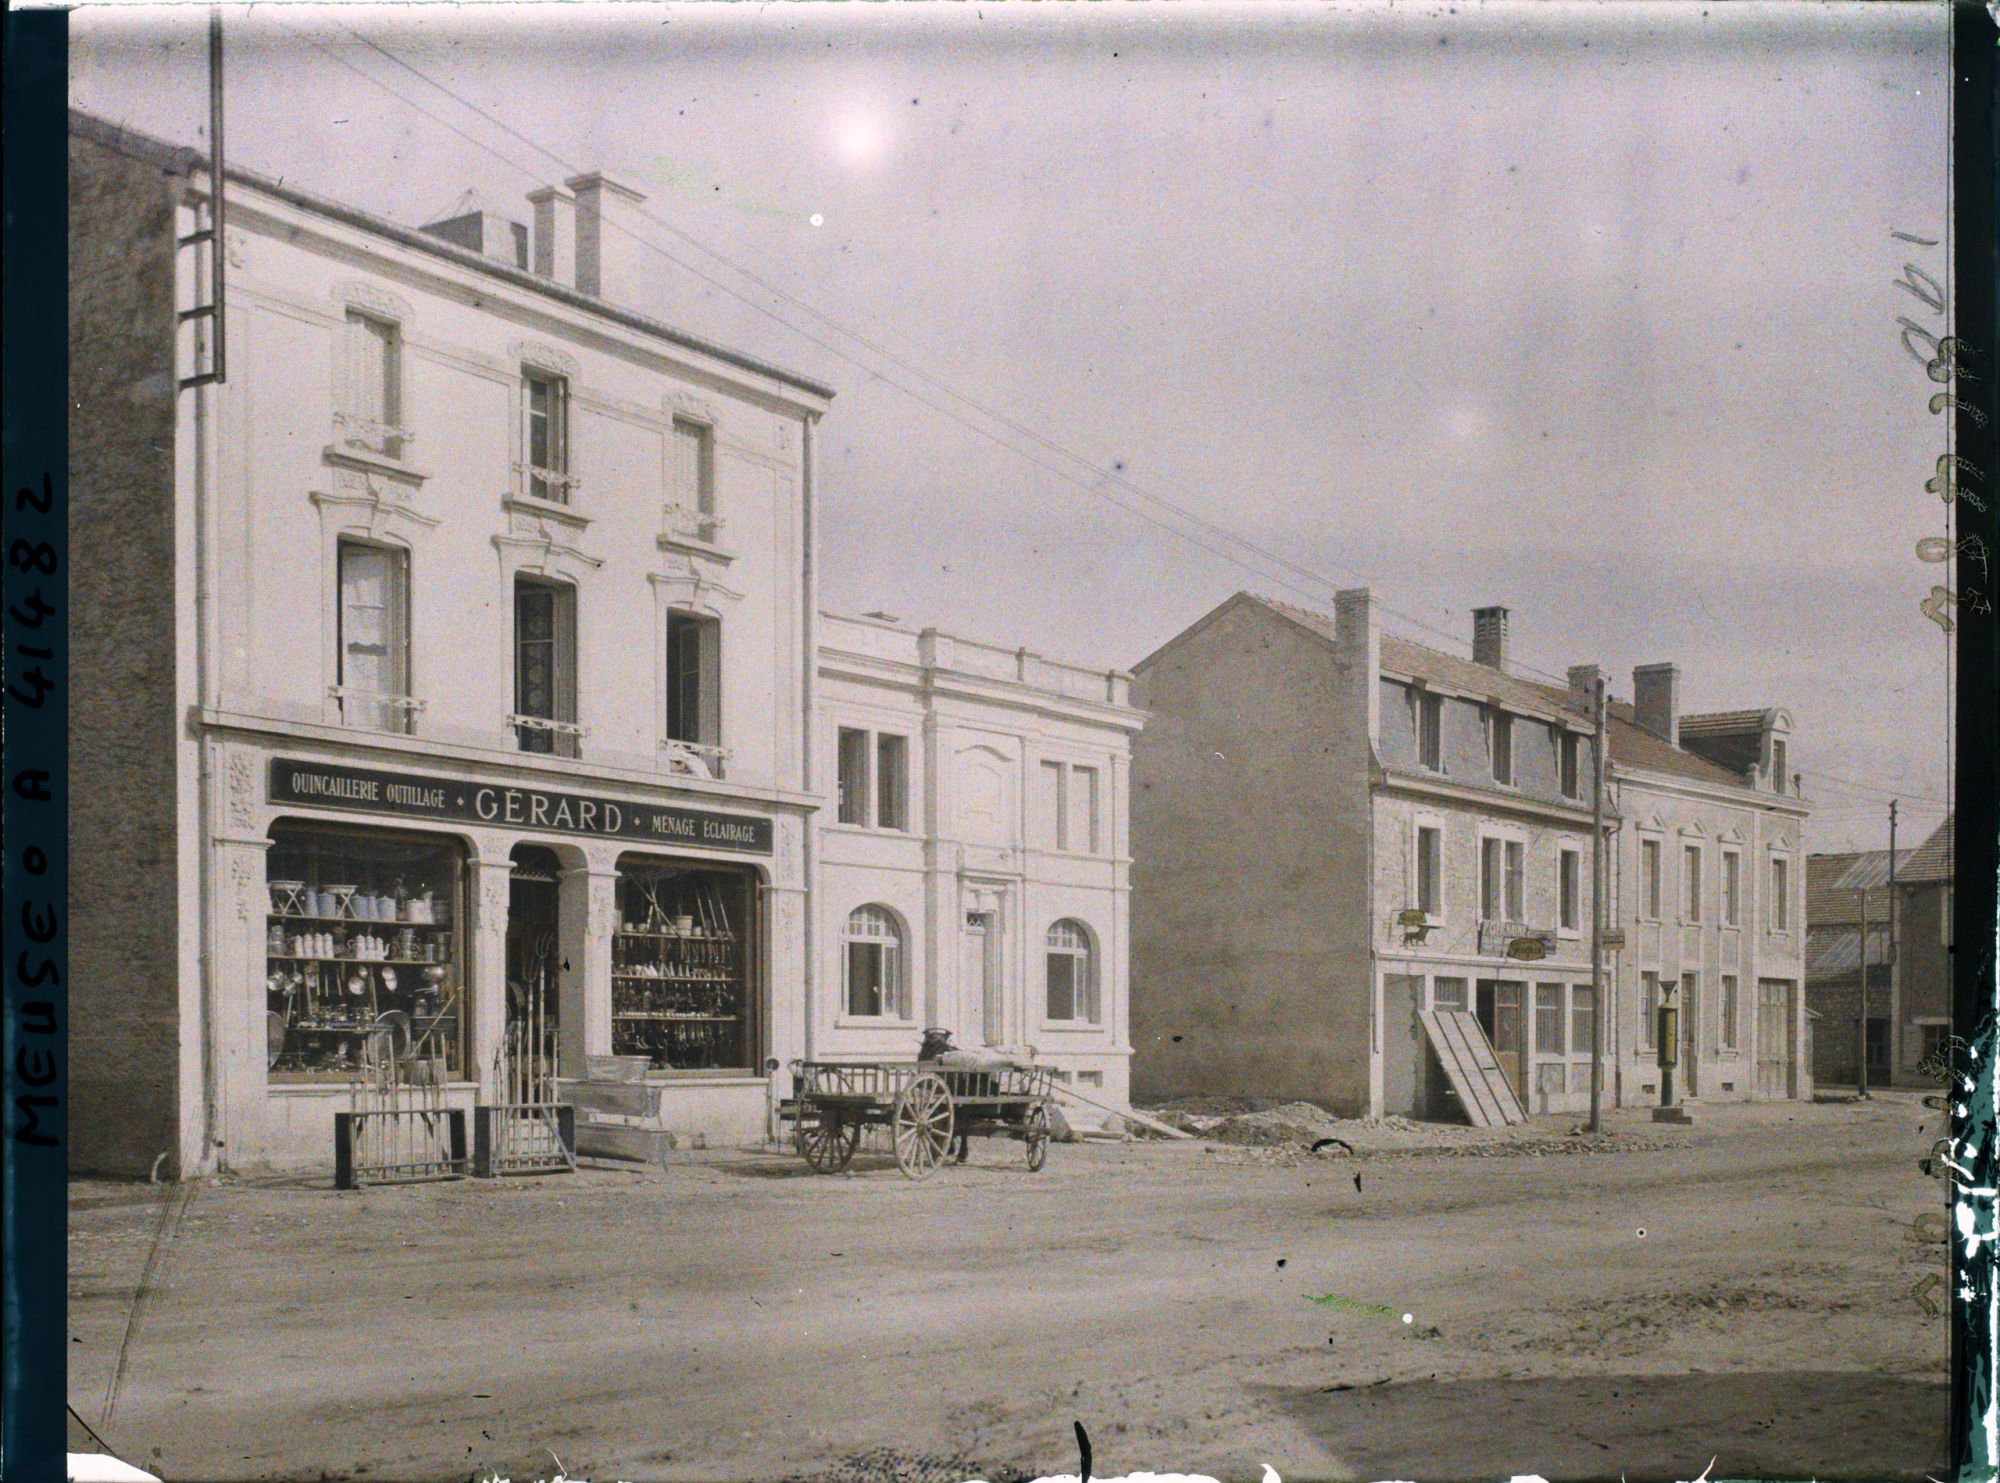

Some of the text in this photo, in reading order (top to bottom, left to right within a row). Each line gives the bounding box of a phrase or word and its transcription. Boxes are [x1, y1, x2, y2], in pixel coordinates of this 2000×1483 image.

[292, 772, 379, 801] QUINCAILLERIE
[386, 783, 445, 809] OUTILLAGE
[475, 788, 622, 833] GÉRARD
[14, 898, 61, 1148] MEUSE
